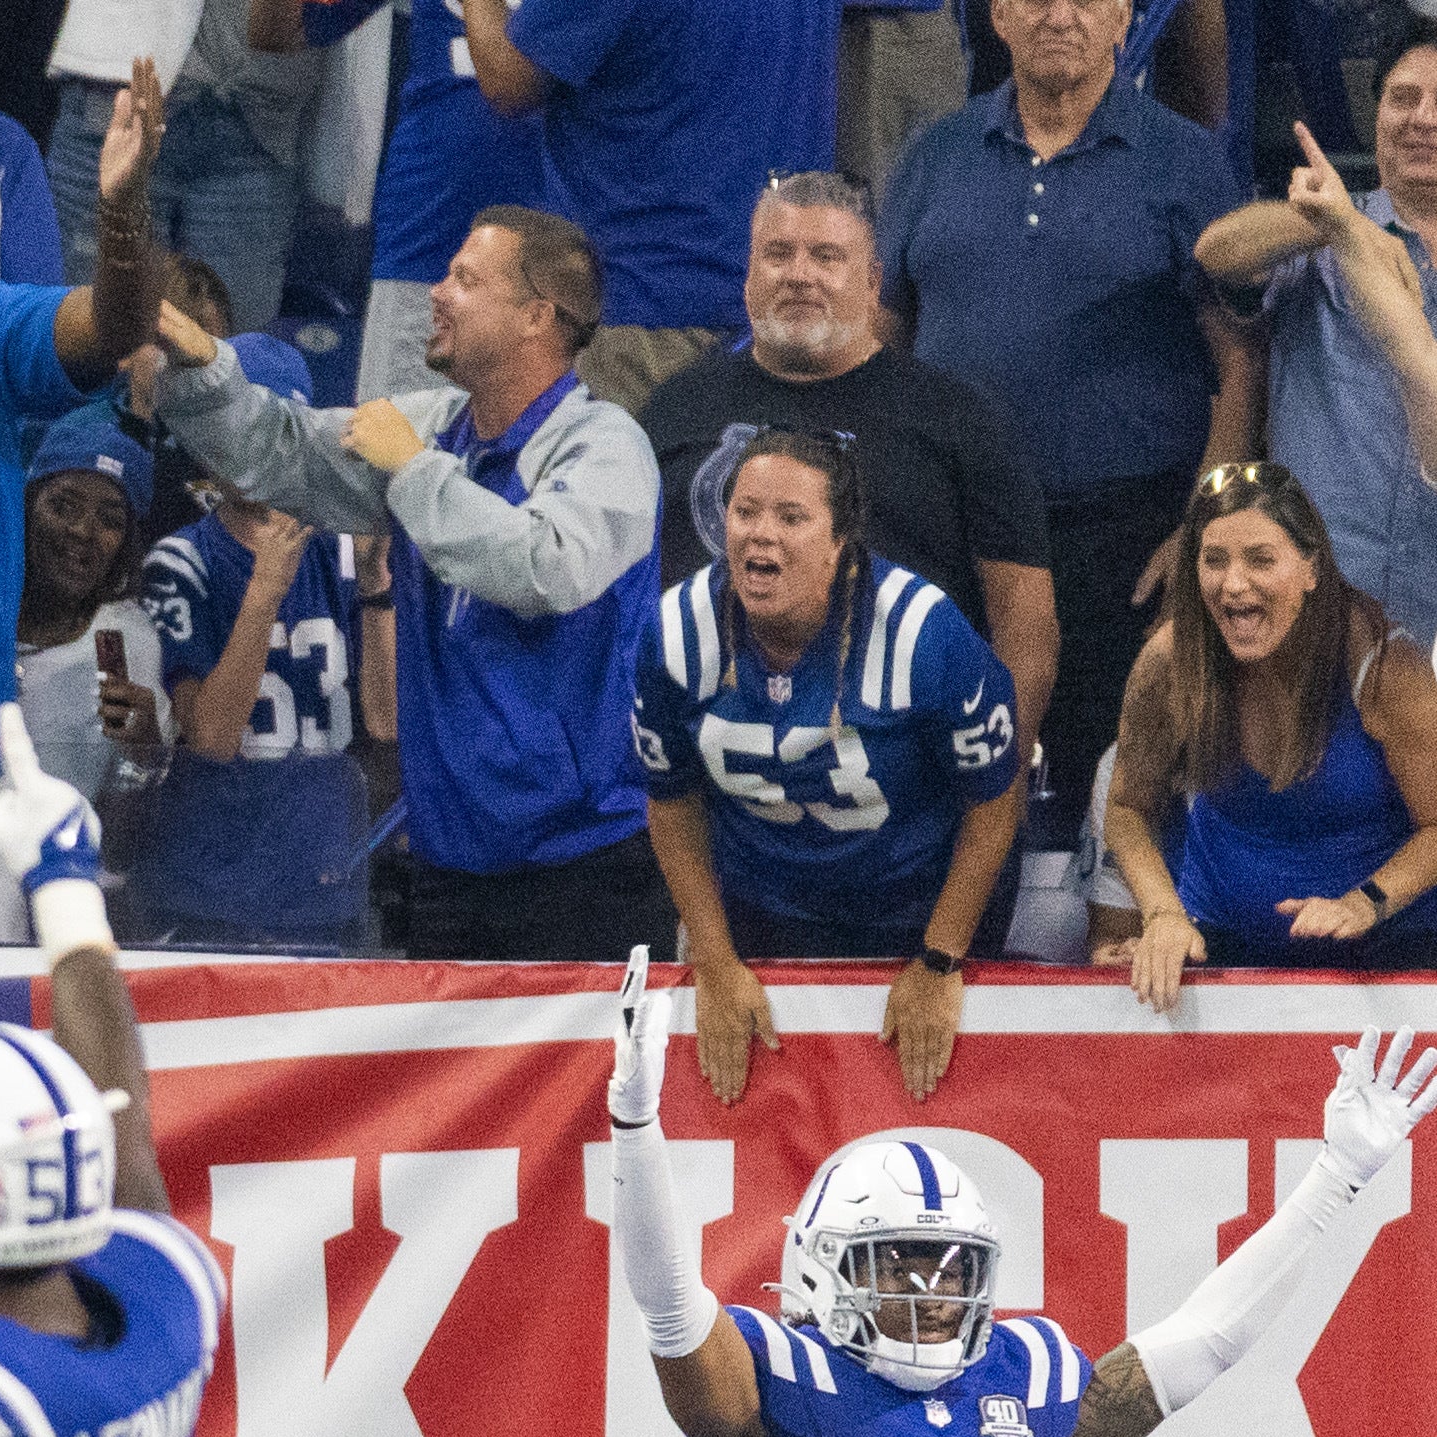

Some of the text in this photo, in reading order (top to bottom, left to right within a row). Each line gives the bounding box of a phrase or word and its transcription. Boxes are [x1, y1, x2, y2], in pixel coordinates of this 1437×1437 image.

[953, 703, 1014, 770] 53
[698, 713, 890, 831] 53
[987, 1400, 1019, 1424] 40
